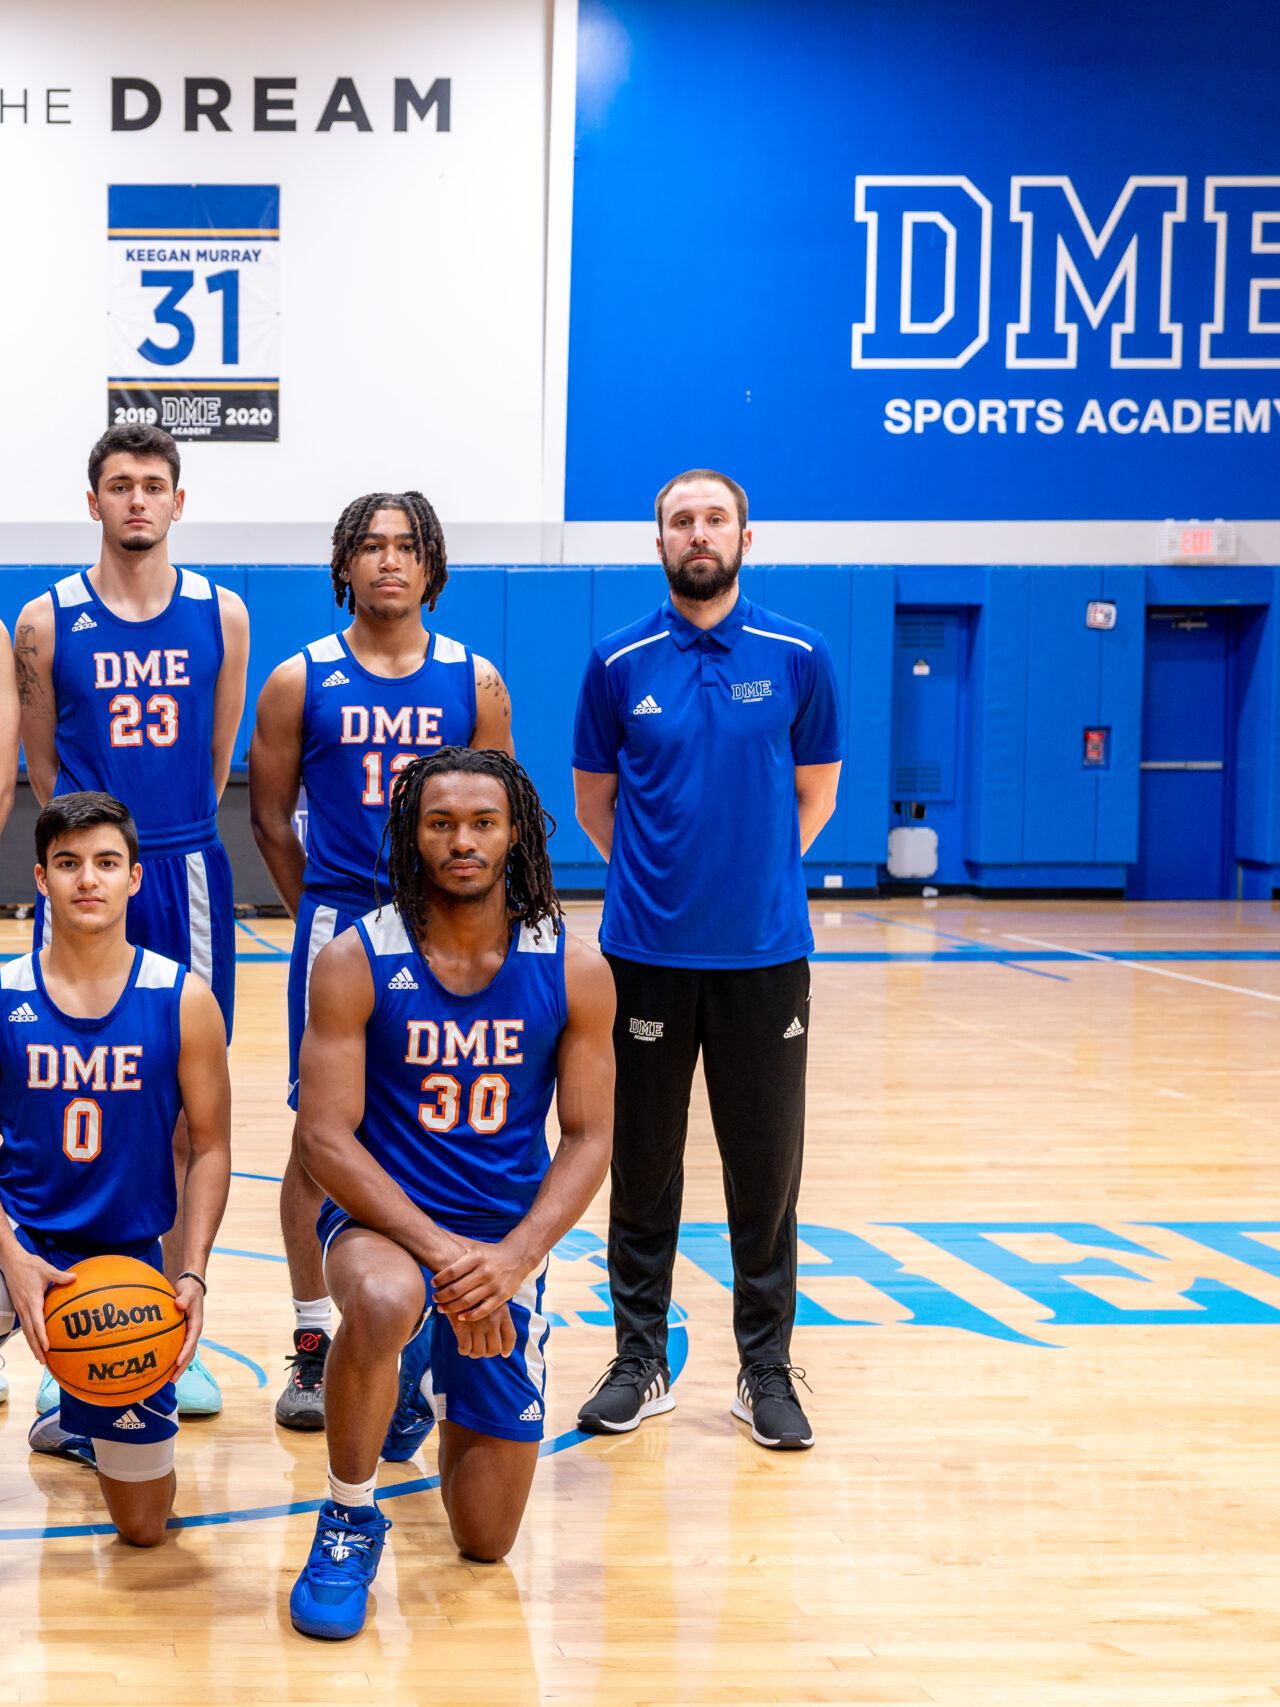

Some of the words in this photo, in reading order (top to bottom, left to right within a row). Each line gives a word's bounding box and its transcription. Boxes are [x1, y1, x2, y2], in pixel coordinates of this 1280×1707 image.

[111, 76, 452, 132] DREAM
[125, 248, 191, 262] KEEGAN
[196, 248, 262, 262] MURRAY
[851, 175, 1280, 370] DME
[136, 268, 239, 366] 31
[114, 407, 158, 426] 2019
[161, 396, 221, 427] DME
[225, 407, 273, 426] 2020
[883, 399, 1065, 435] SPORTS
[1076, 399, 1280, 434] ACADEM
[170, 427, 212, 436] ACADEMY
[1181, 529, 1212, 555] EXIT
[71, 622, 97, 632] adidas
[93, 649, 190, 689] DME
[322, 678, 350, 687] adidas
[731, 680, 772, 700] DME
[109, 693, 179, 747] 23
[340, 705, 443, 745] DME
[632, 707, 662, 715] adidas
[388, 982, 419, 990] adidas
[8, 1014, 38, 1023] adidas
[629, 1017, 664, 1037] DME
[783, 1027, 805, 1039] adidas
[404, 1019, 524, 1066] DME
[26, 1043, 143, 1091] DME
[418, 1072, 510, 1134] 30
[62, 1097, 103, 1163] 0
[62, 1302, 163, 1340] Wilson
[87, 1350, 157, 1381] NCAA
[112, 1422, 146, 1430] adidas
